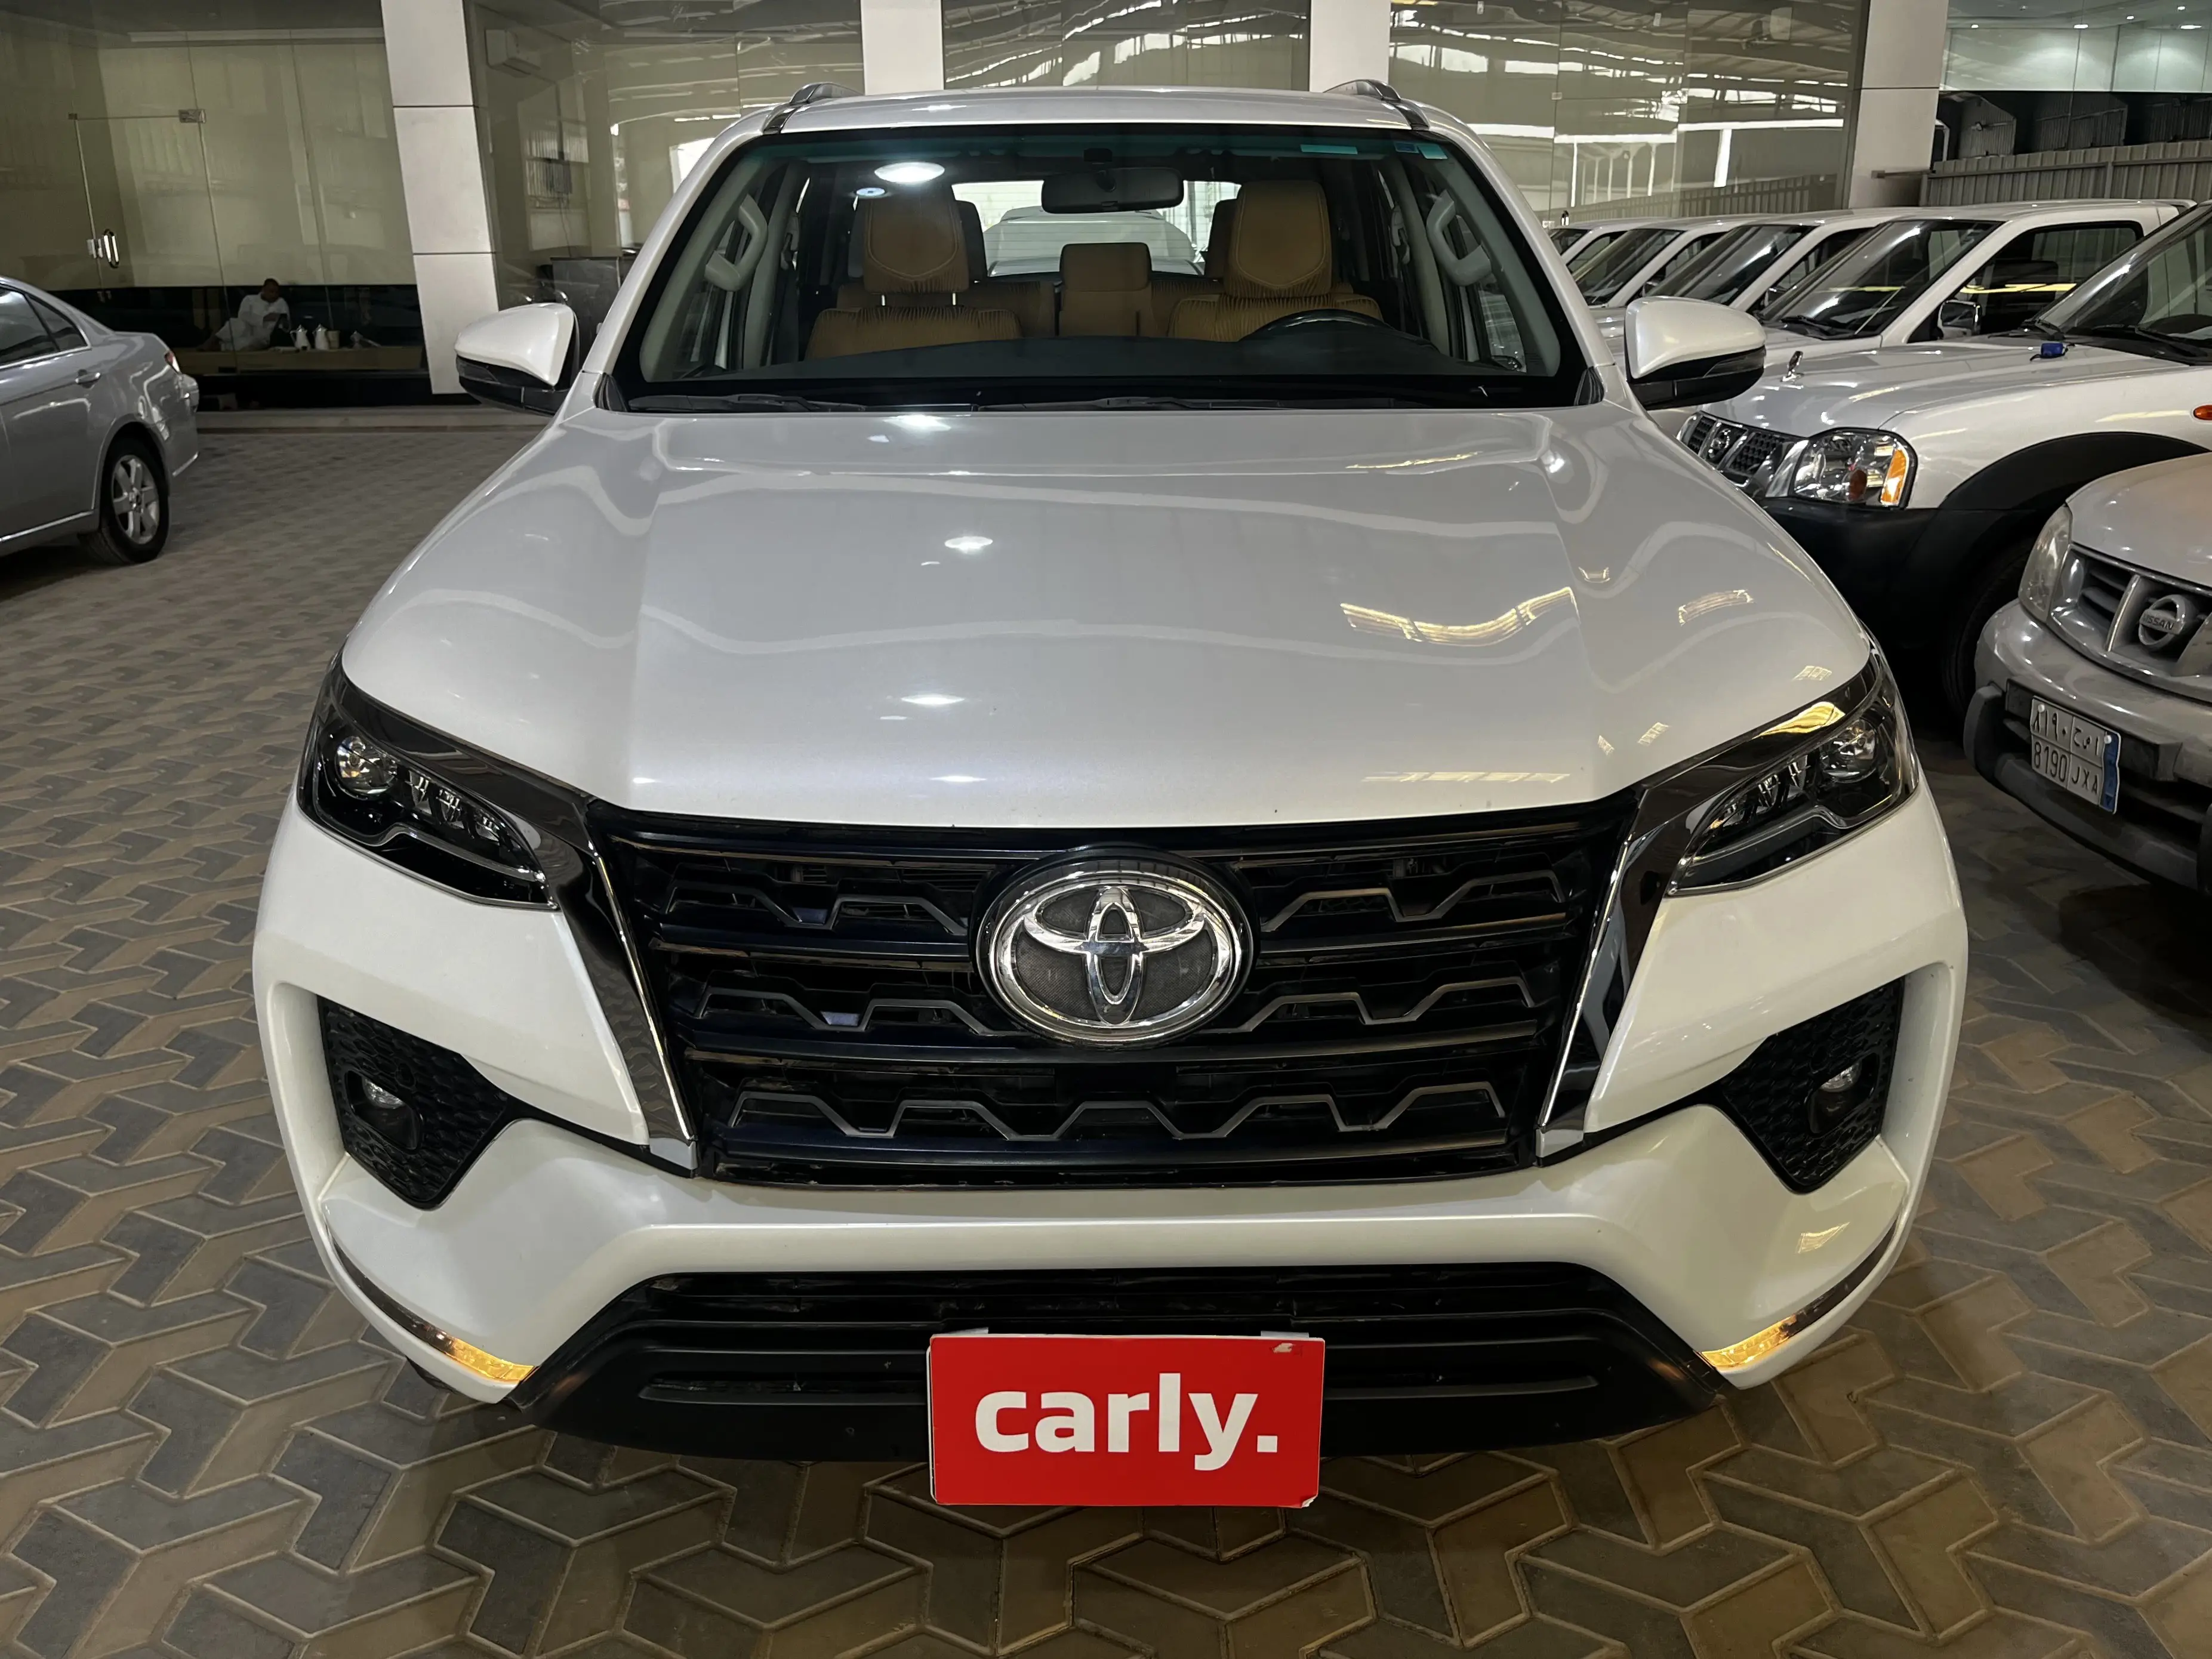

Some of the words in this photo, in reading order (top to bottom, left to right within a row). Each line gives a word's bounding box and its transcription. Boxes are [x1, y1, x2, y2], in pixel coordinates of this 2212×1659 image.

[2142, 613, 2174, 631] NISSAN
[2034, 741, 2068, 782] 8190
[2072, 766, 2098, 795] JXA
[975, 1373, 1277, 1471] carly.
